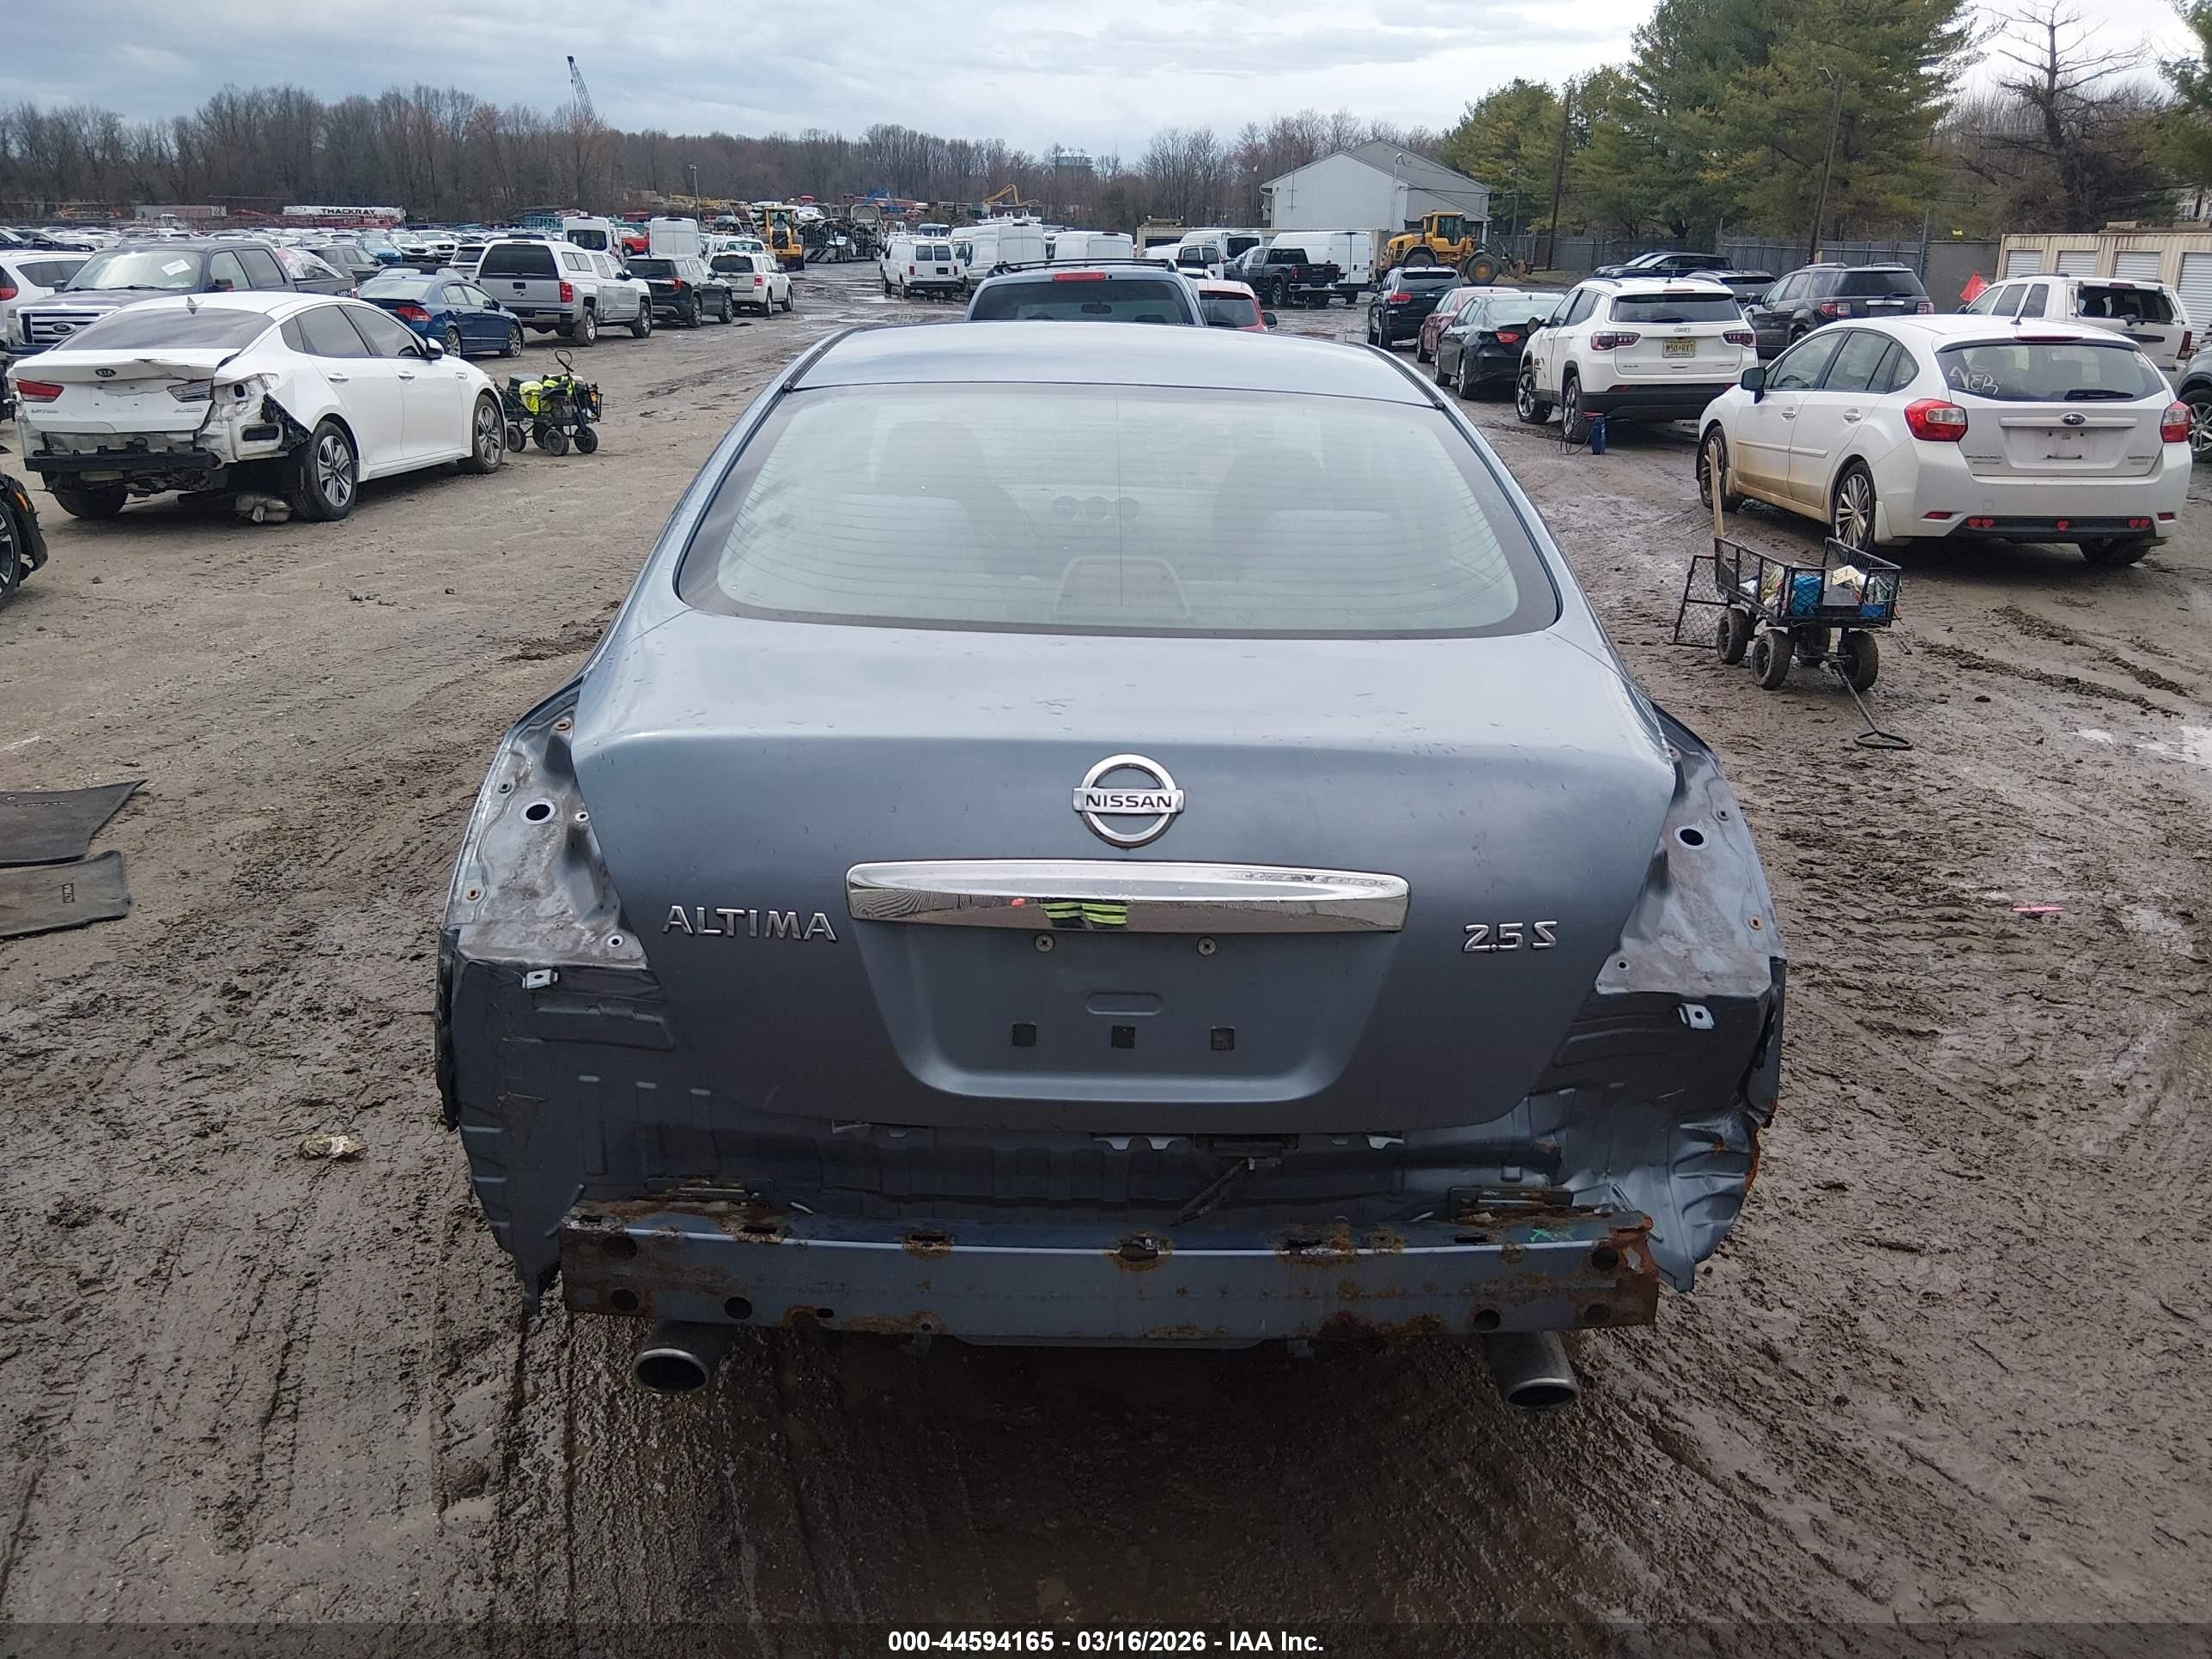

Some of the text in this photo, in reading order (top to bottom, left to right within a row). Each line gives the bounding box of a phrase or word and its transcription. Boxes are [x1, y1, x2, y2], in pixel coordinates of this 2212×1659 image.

[1085, 794, 1172, 808] NISSAN
[662, 905, 837, 942] ALTIMA
[1531, 921, 1558, 948] S
